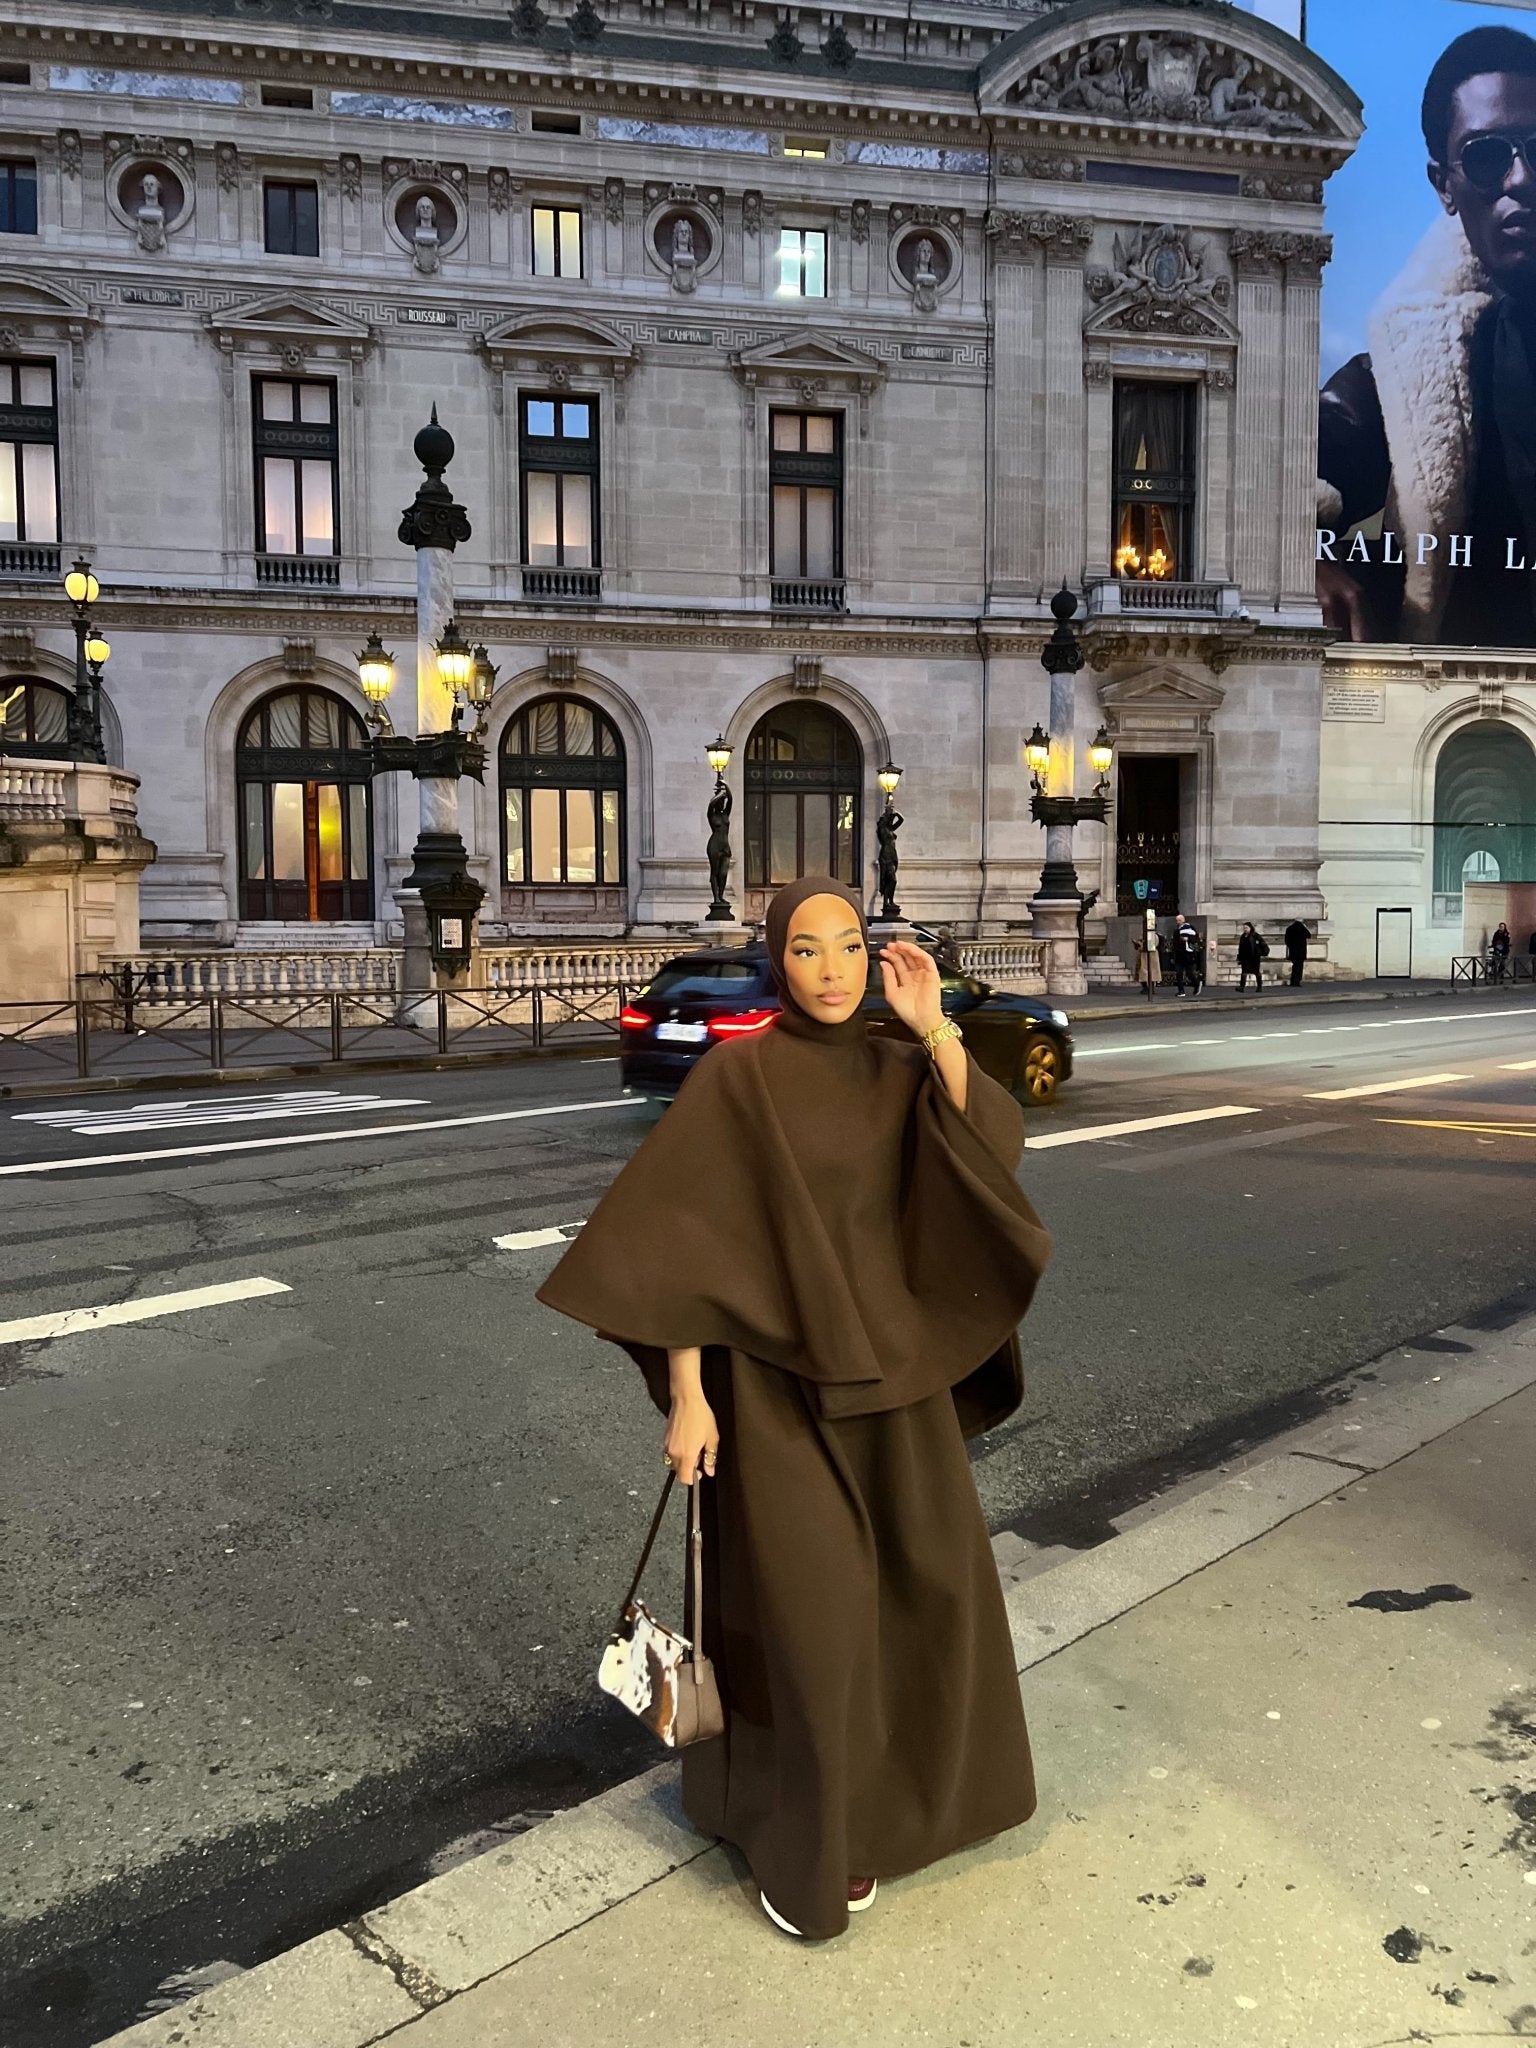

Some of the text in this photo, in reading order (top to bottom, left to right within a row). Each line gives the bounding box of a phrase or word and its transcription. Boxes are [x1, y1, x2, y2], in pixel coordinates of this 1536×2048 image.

[408, 309, 446, 324] ROUSSEAU
[1315, 529, 1536, 570] RALPH L
